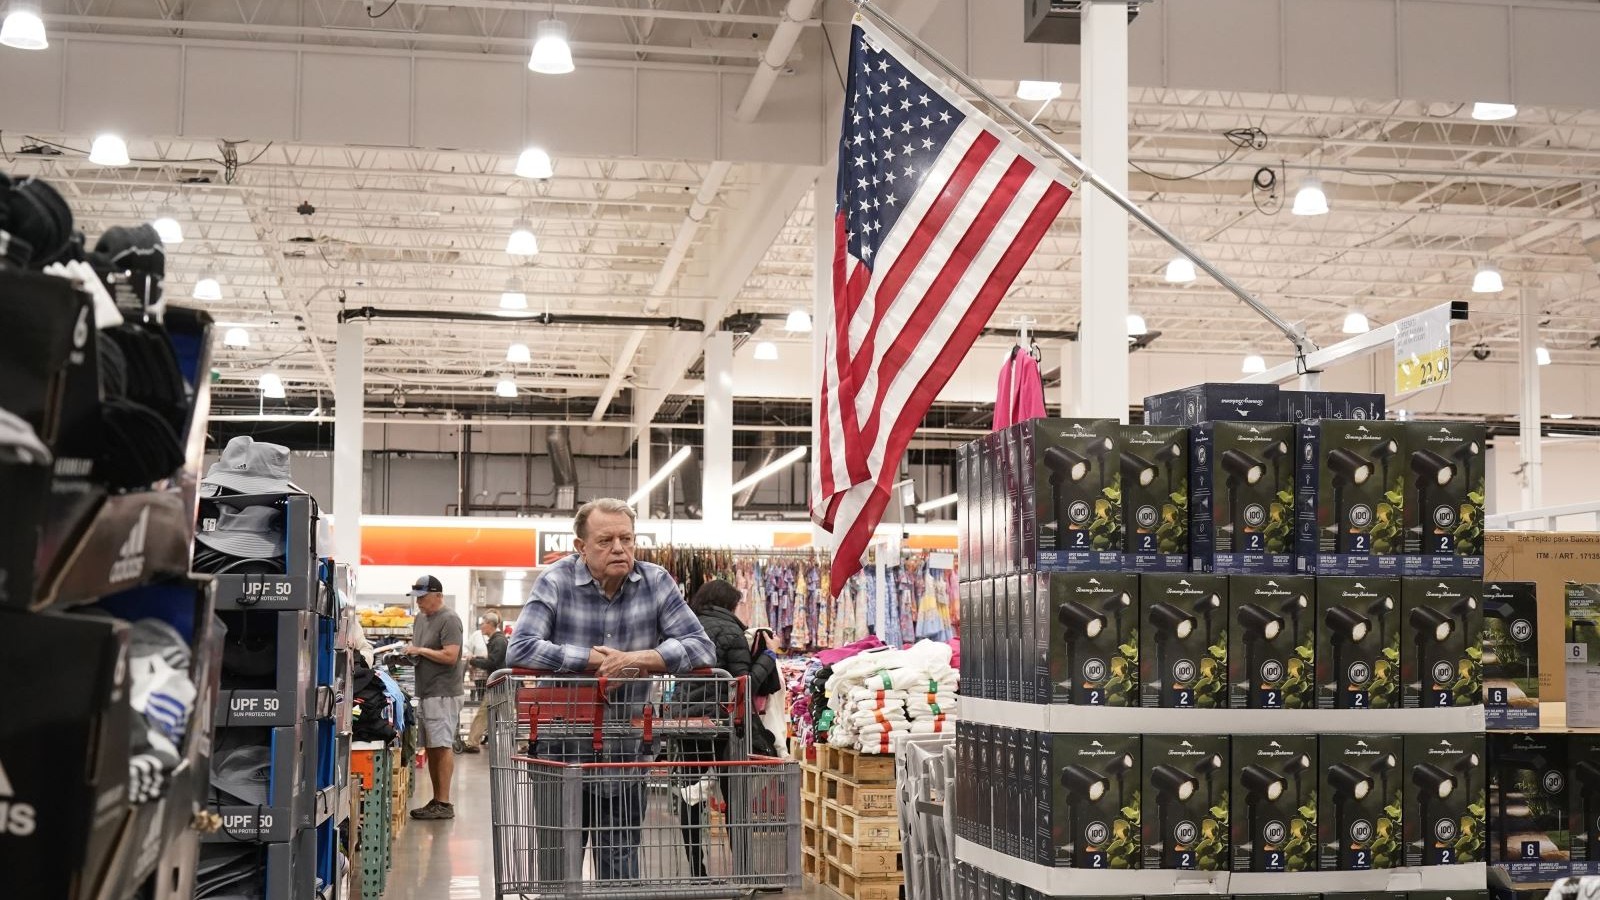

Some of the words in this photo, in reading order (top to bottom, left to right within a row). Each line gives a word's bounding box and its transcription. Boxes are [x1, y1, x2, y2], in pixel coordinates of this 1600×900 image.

[1060, 431, 1077, 439] Tommy
[1344, 434, 1361, 442] Tommy
[1076, 533, 1084, 545] 2
[1144, 536, 1151, 548] 2
[1251, 535, 1258, 547] 2
[1356, 536, 1364, 548] 2
[1441, 536, 1448, 549] 2
[242, 582, 270, 595] UPF
[276, 582, 291, 595] 50
[1516, 626, 1526, 634] 30
[1573, 646, 1580, 656] 6
[1088, 666, 1100, 674] 100
[1179, 667, 1190, 675] 100
[1266, 667, 1277, 675] 100
[1090, 691, 1098, 704] 2
[1180, 692, 1188, 704] 2
[1268, 692, 1275, 705] 2
[1355, 693, 1363, 706] 2
[1440, 693, 1447, 705] 2
[1494, 690, 1502, 702] 6
[230, 699, 258, 710] UPF
[264, 699, 279, 710] 50
[224, 816, 252, 828] UPF
[260, 815, 272, 828] 50
[1092, 829, 1102, 838] 100
[1181, 828, 1192, 837] 100
[1269, 828, 1281, 836] 100
[1356, 827, 1367, 836] 100
[1440, 826, 1451, 834] 100
[1527, 844, 1534, 856] 6
[1093, 854, 1101, 868] 2
[1181, 854, 1190, 866] 2
[1271, 853, 1279, 866] 2
[1357, 852, 1365, 864] 2
[1442, 851, 1450, 862] 2
